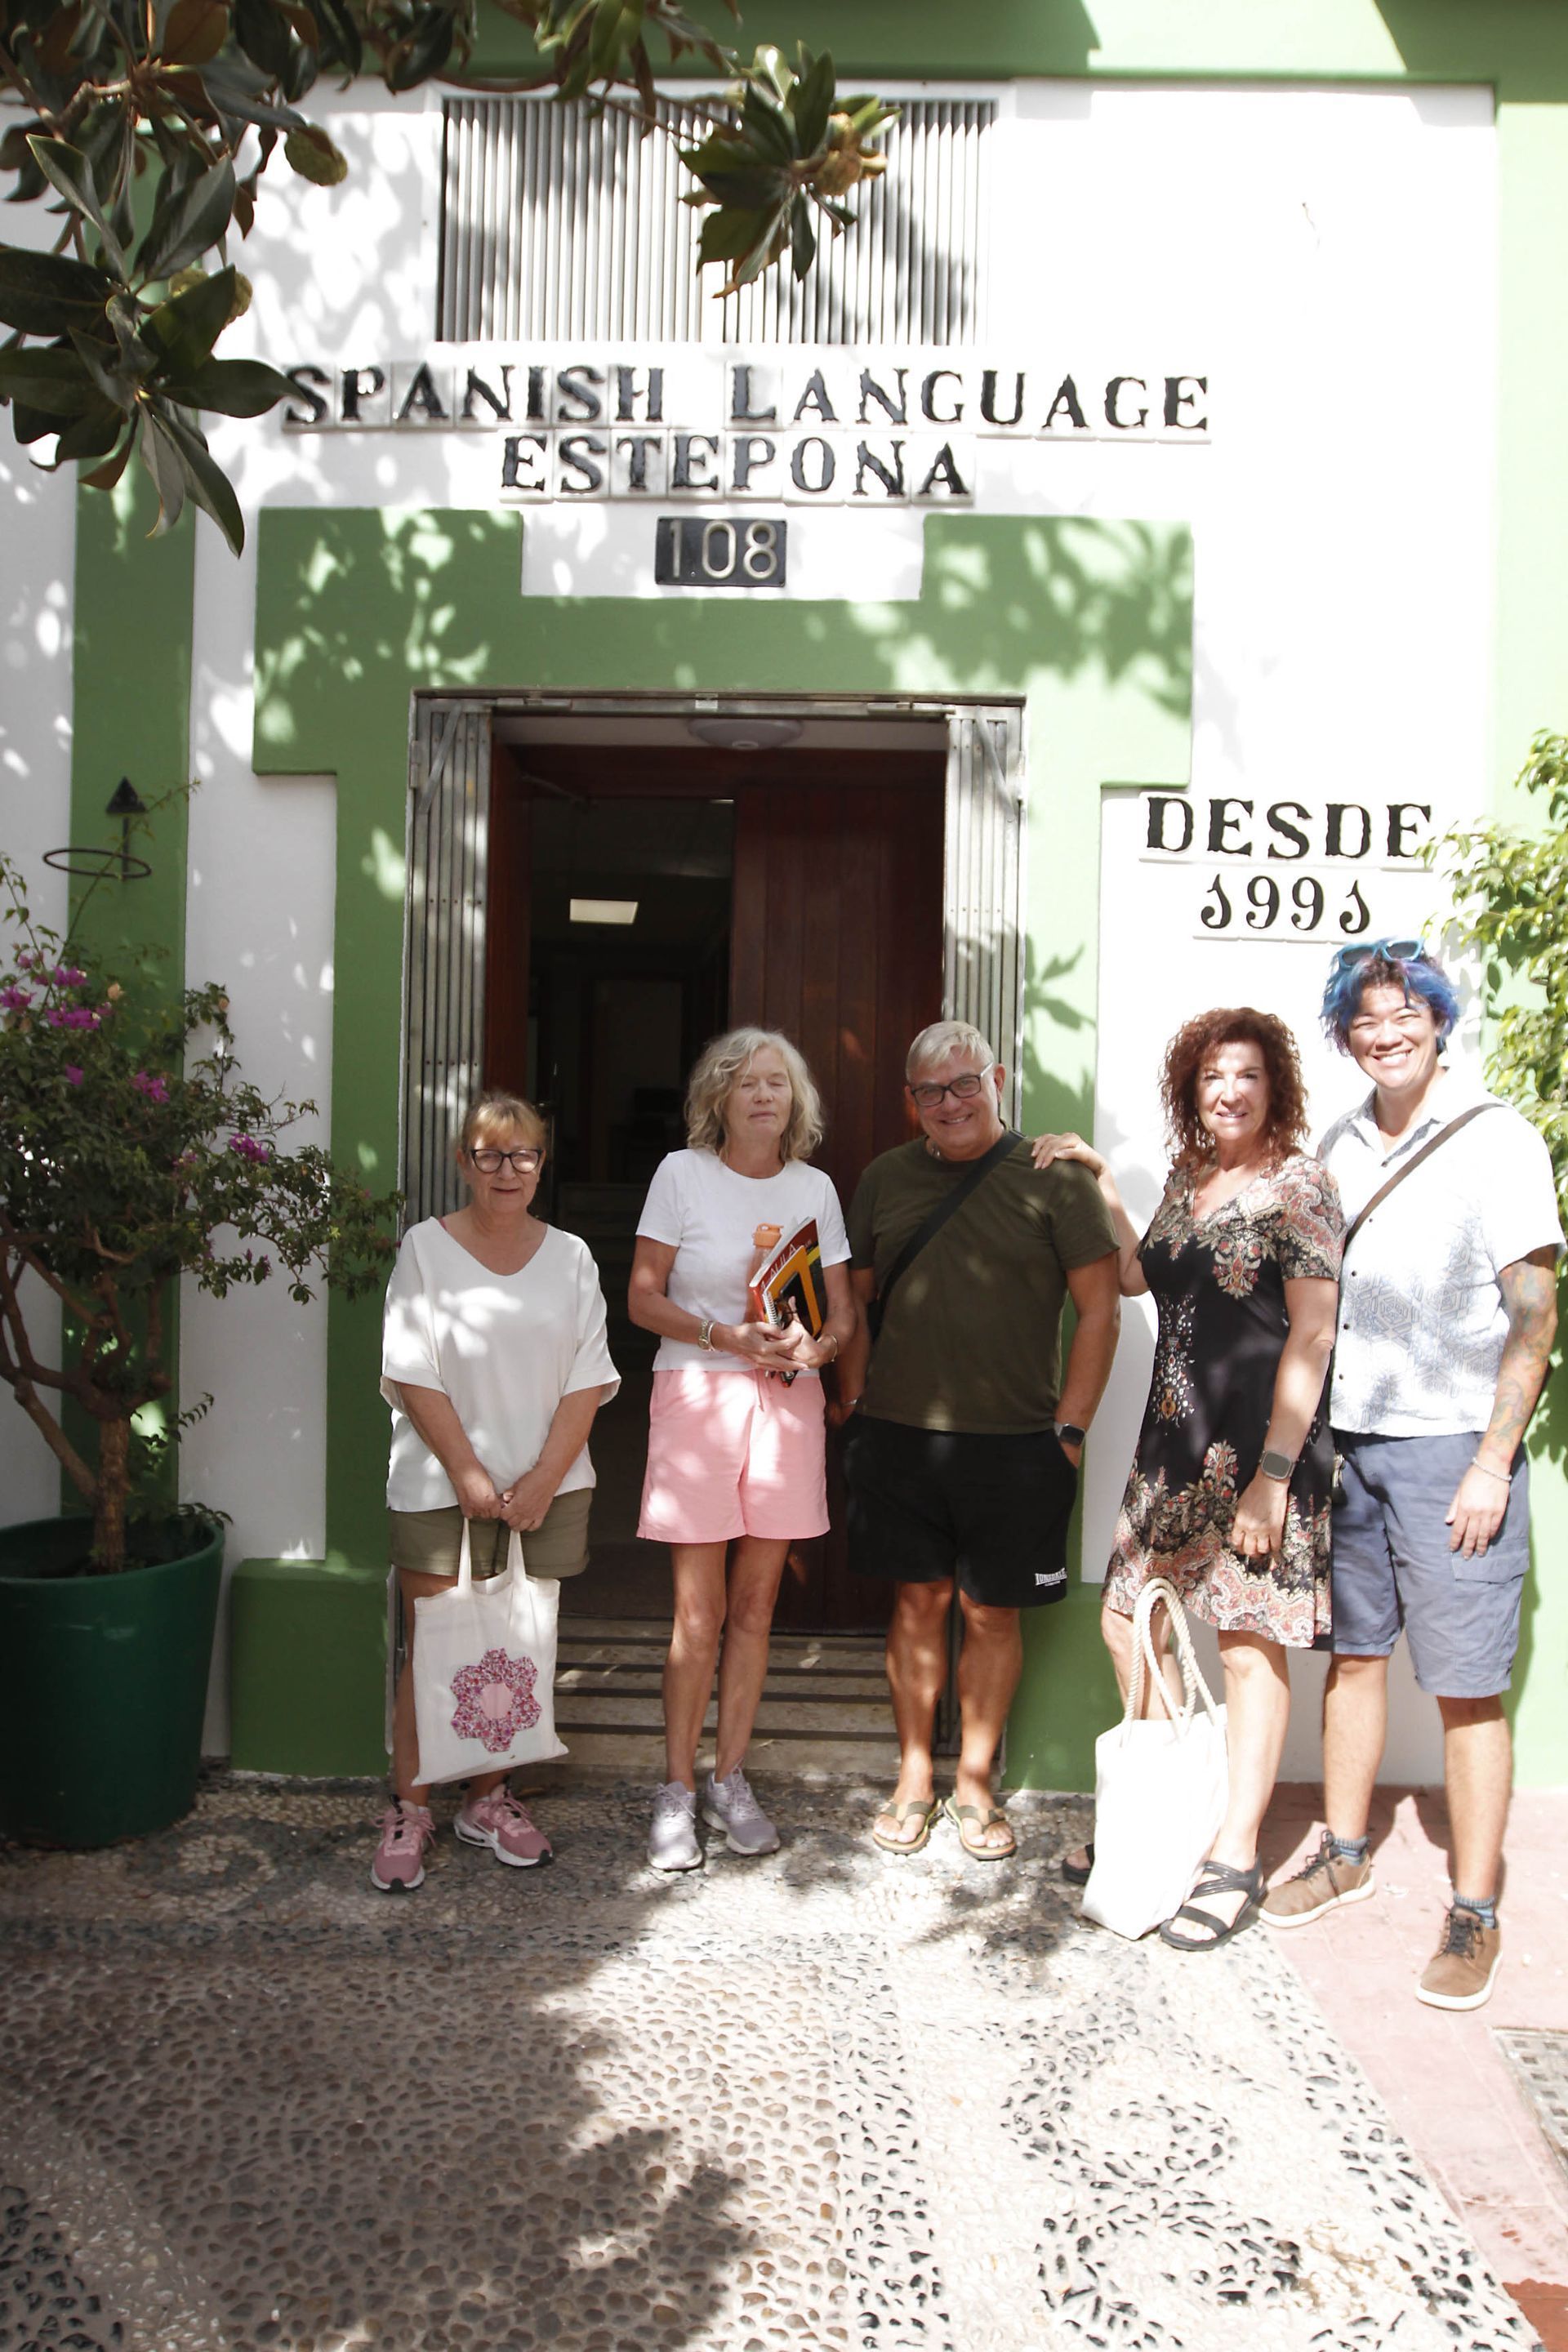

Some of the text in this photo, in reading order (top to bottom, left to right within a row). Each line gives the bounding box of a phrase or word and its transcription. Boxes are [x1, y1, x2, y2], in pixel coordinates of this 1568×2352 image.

[283, 364, 1209, 430] SPANISH LANGUAGE
[501, 433, 970, 497] ESTEPONA
[669, 519, 778, 580] 108
[1147, 796, 1432, 861] DESDE
